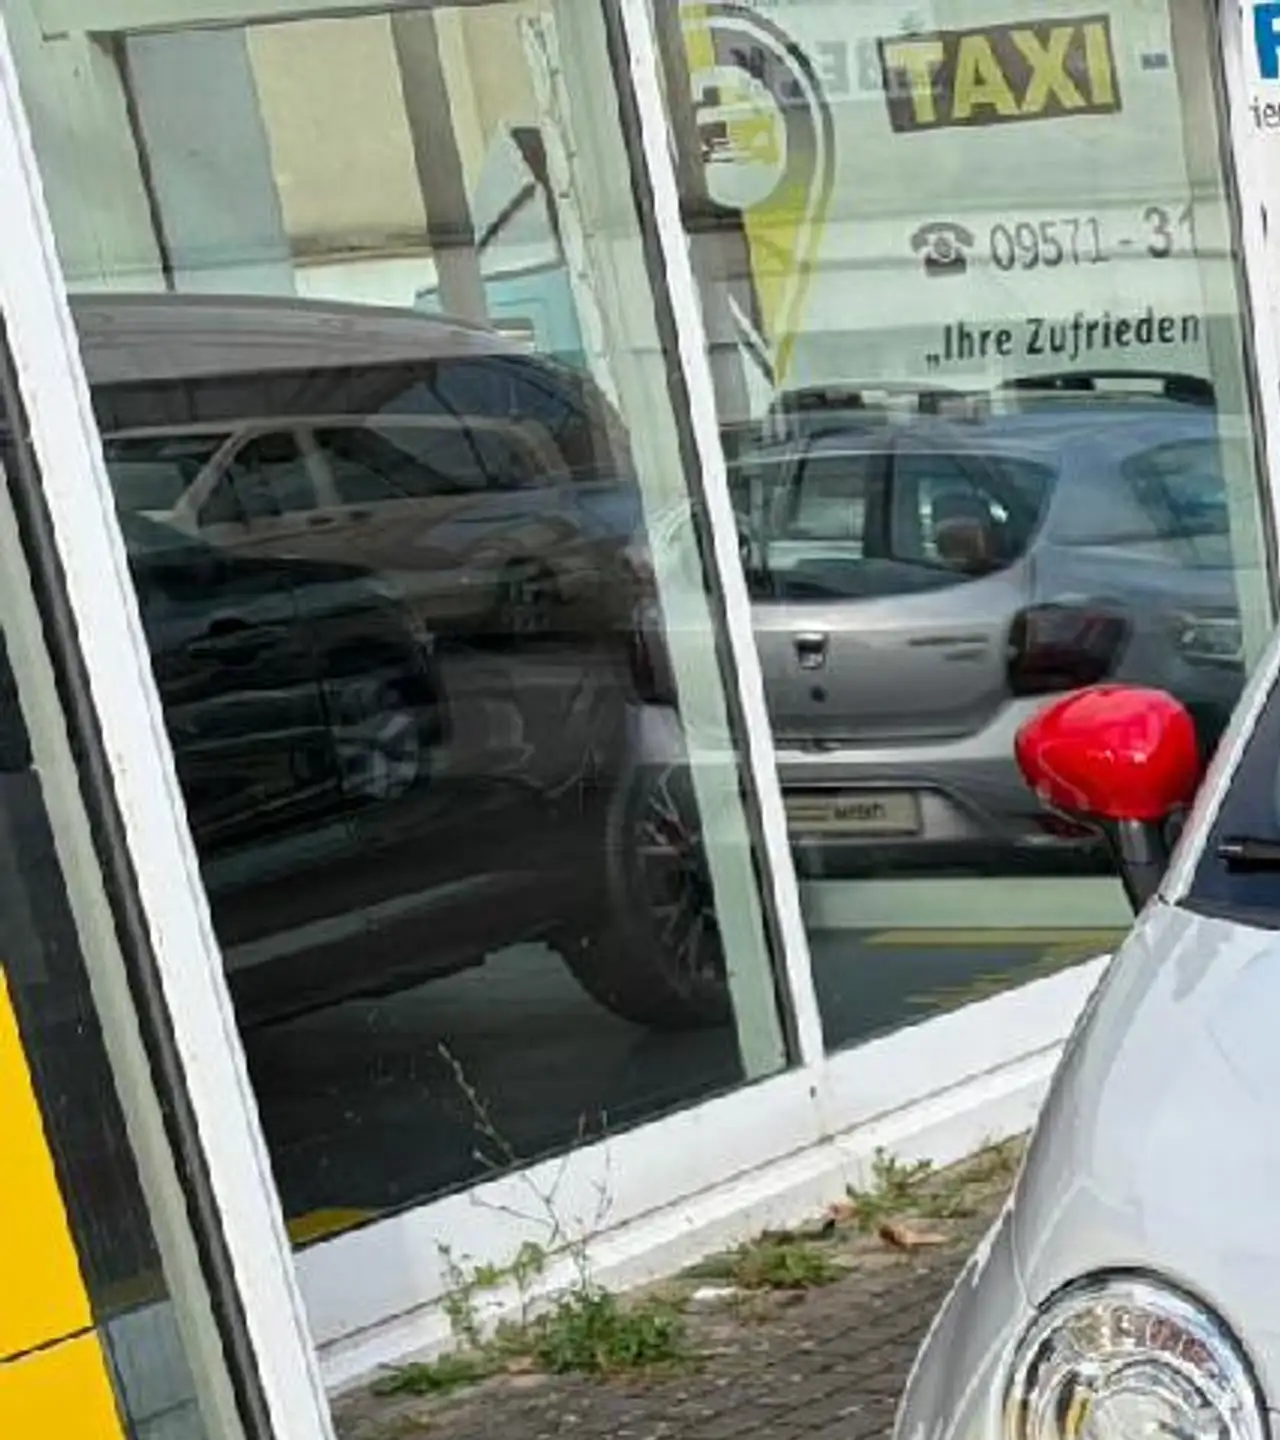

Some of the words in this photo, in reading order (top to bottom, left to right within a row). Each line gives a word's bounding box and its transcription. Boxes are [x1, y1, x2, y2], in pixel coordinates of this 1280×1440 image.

[885, 22, 1114, 124] TAXI
[990, 217, 1111, 271] 09571
[1026, 304, 1200, 362] Zufrieden
